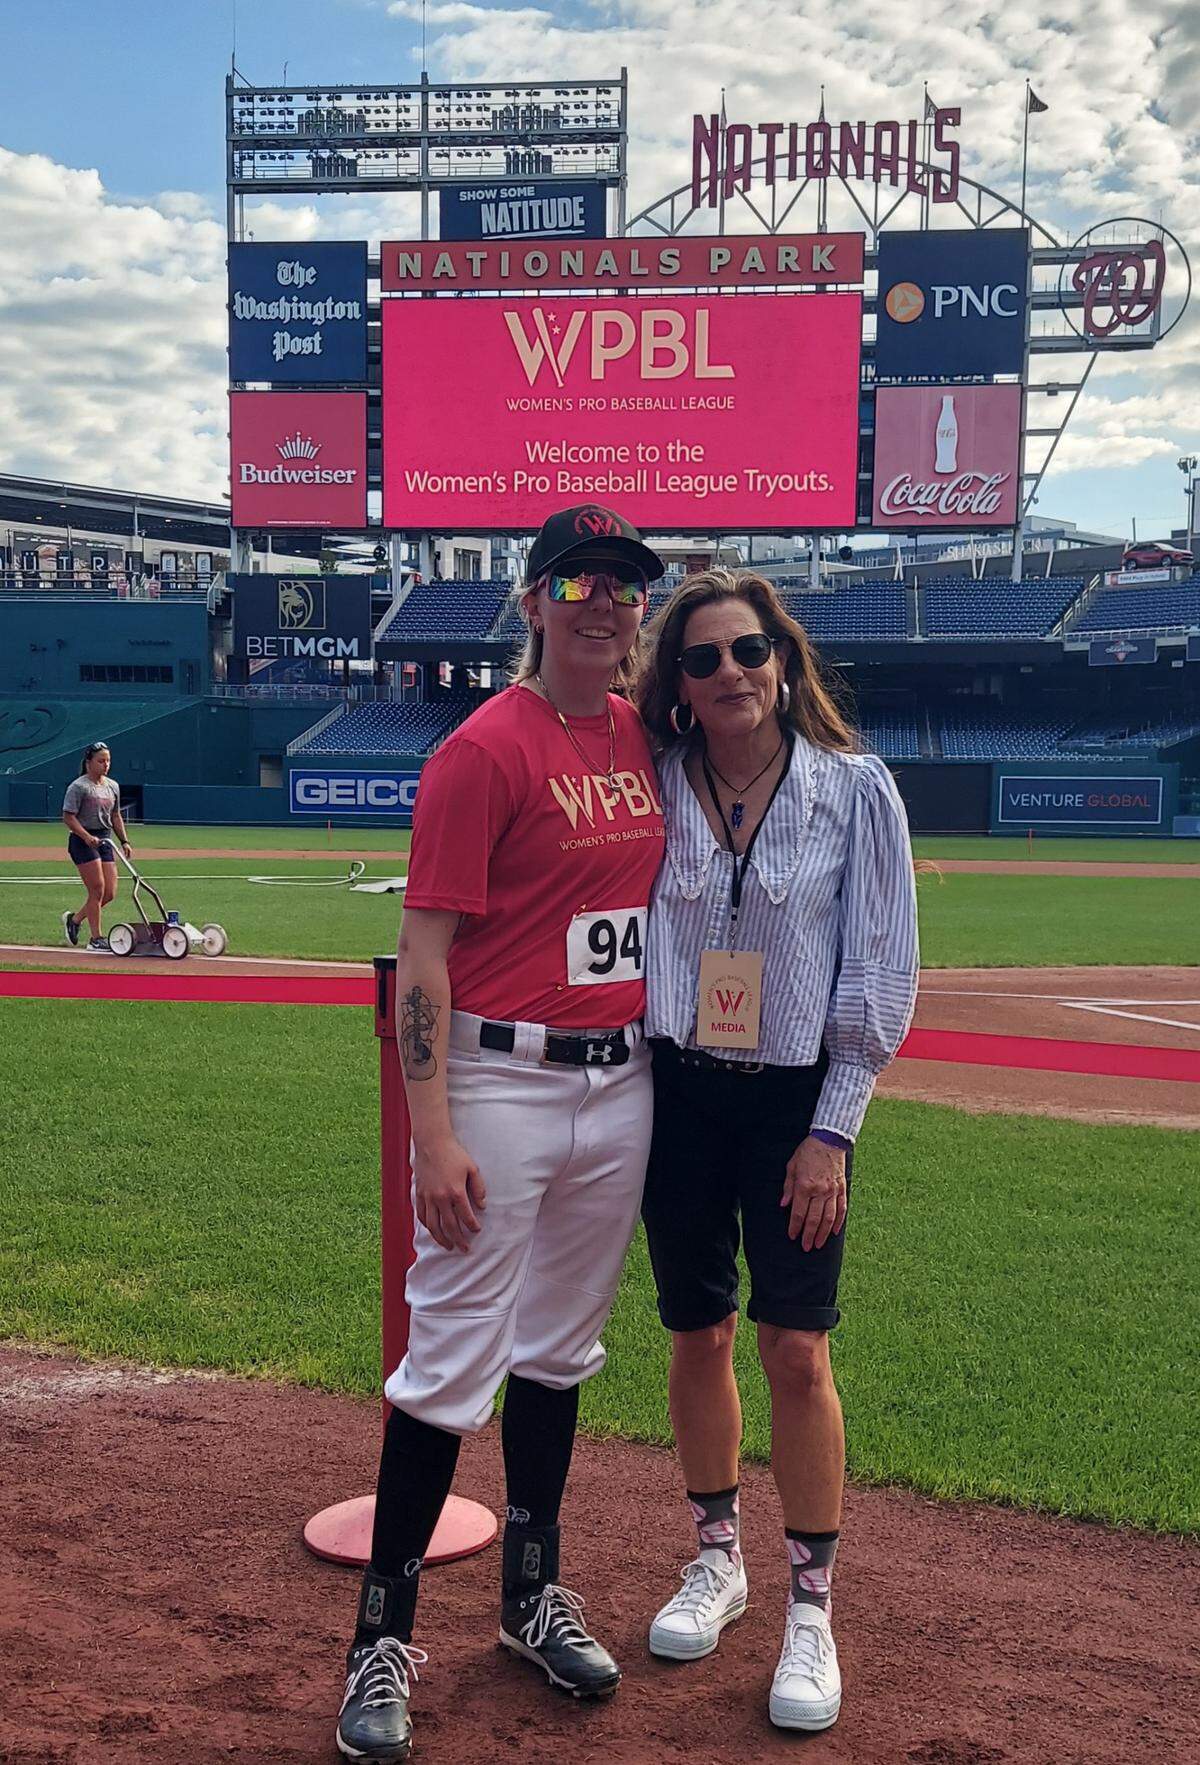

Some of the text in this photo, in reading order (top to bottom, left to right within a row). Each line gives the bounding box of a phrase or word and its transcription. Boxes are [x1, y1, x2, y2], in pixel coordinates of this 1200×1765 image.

[692, 107, 961, 208] NATIONALS
[459, 187, 535, 202] SHOW SOME
[481, 196, 586, 234] NATITUDE
[276, 260, 318, 289] The
[398, 244, 836, 280] NATIONALS PARK
[234, 291, 362, 326] Washington
[932, 284, 1018, 318] PNC
[272, 330, 323, 362] Post
[503, 307, 736, 387] WPBL
[507, 396, 735, 412] WOMEN'S PRO BASEBALL LEAGUE
[525, 440, 704, 464] Welcome to the
[239, 463, 357, 484] Budweiser
[404, 469, 835, 498] Women's Pro Baseball League Tryouts.
[880, 472, 1011, 516] Coca-Cola
[247, 636, 358, 657] BETMGM
[1009, 794, 1151, 807] VENTURE GLOBAL
[559, 833, 604, 851] WOMEN'S
[606, 830, 621, 842] PRO
[622, 827, 654, 841] BASEBALL
[587, 915, 643, 976] 94
[711, 1022, 746, 1033] MEDIA
